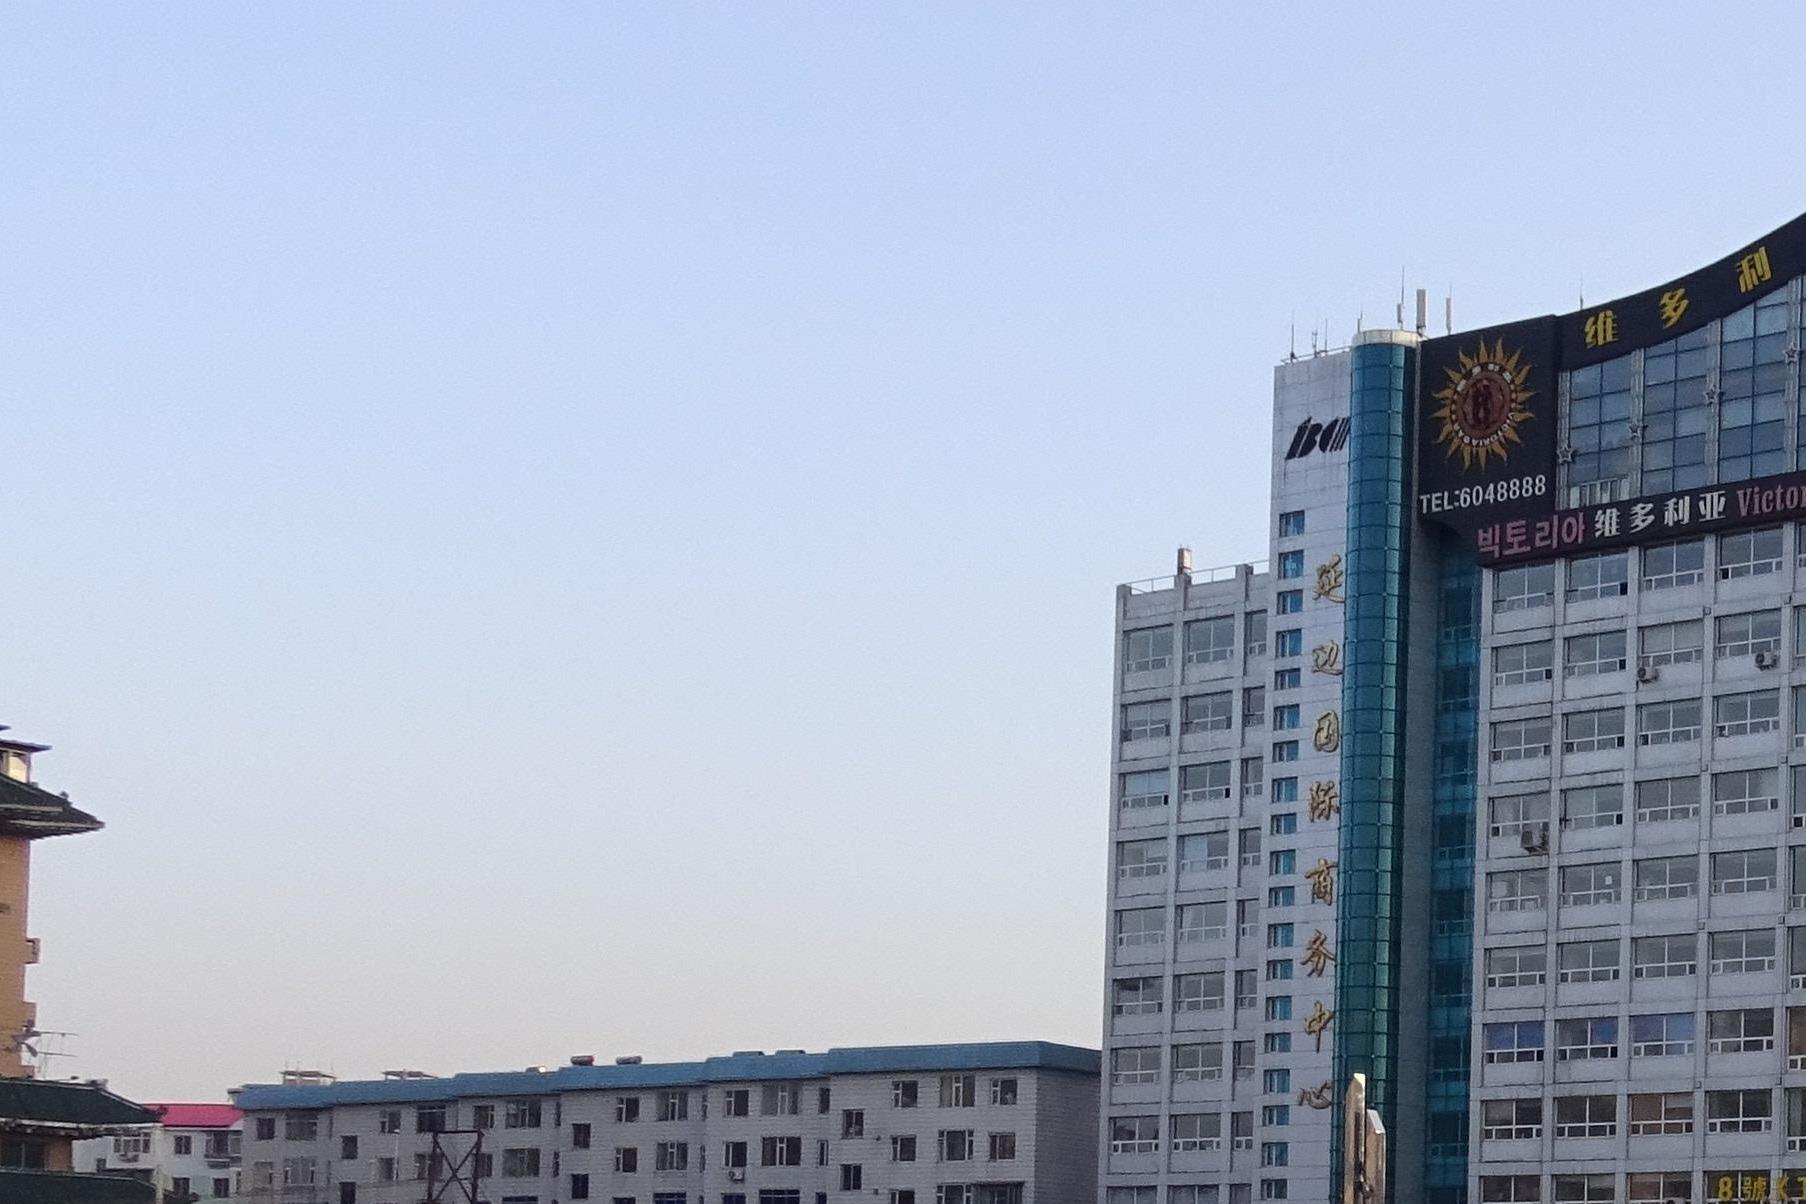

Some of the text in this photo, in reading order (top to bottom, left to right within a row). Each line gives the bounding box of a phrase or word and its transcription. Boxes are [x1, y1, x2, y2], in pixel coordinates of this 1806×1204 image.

[1419, 474, 1547, 515] TEL:6048888
[1477, 511, 1586, 555] 빅토리아
[1593, 491, 1728, 539] 维多利亚
